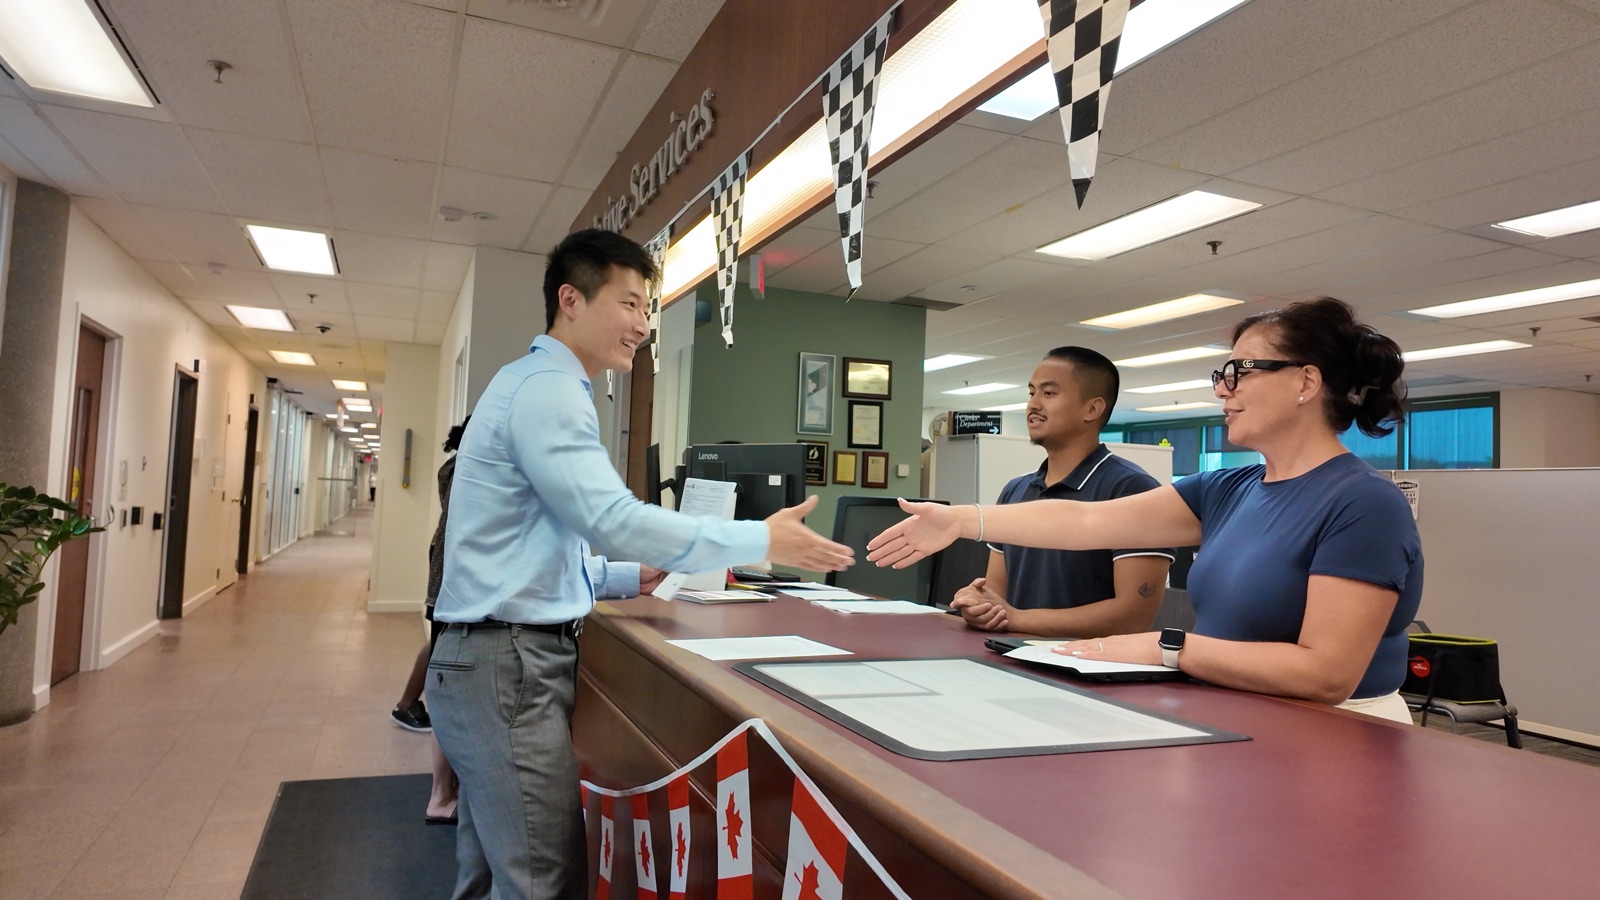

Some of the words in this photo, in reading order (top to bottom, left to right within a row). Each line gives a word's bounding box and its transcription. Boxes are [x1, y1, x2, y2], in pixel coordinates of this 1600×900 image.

[629, 87, 716, 218] Services
[959, 420, 993, 429] Department
[698, 451, 719, 460] Lenovo
